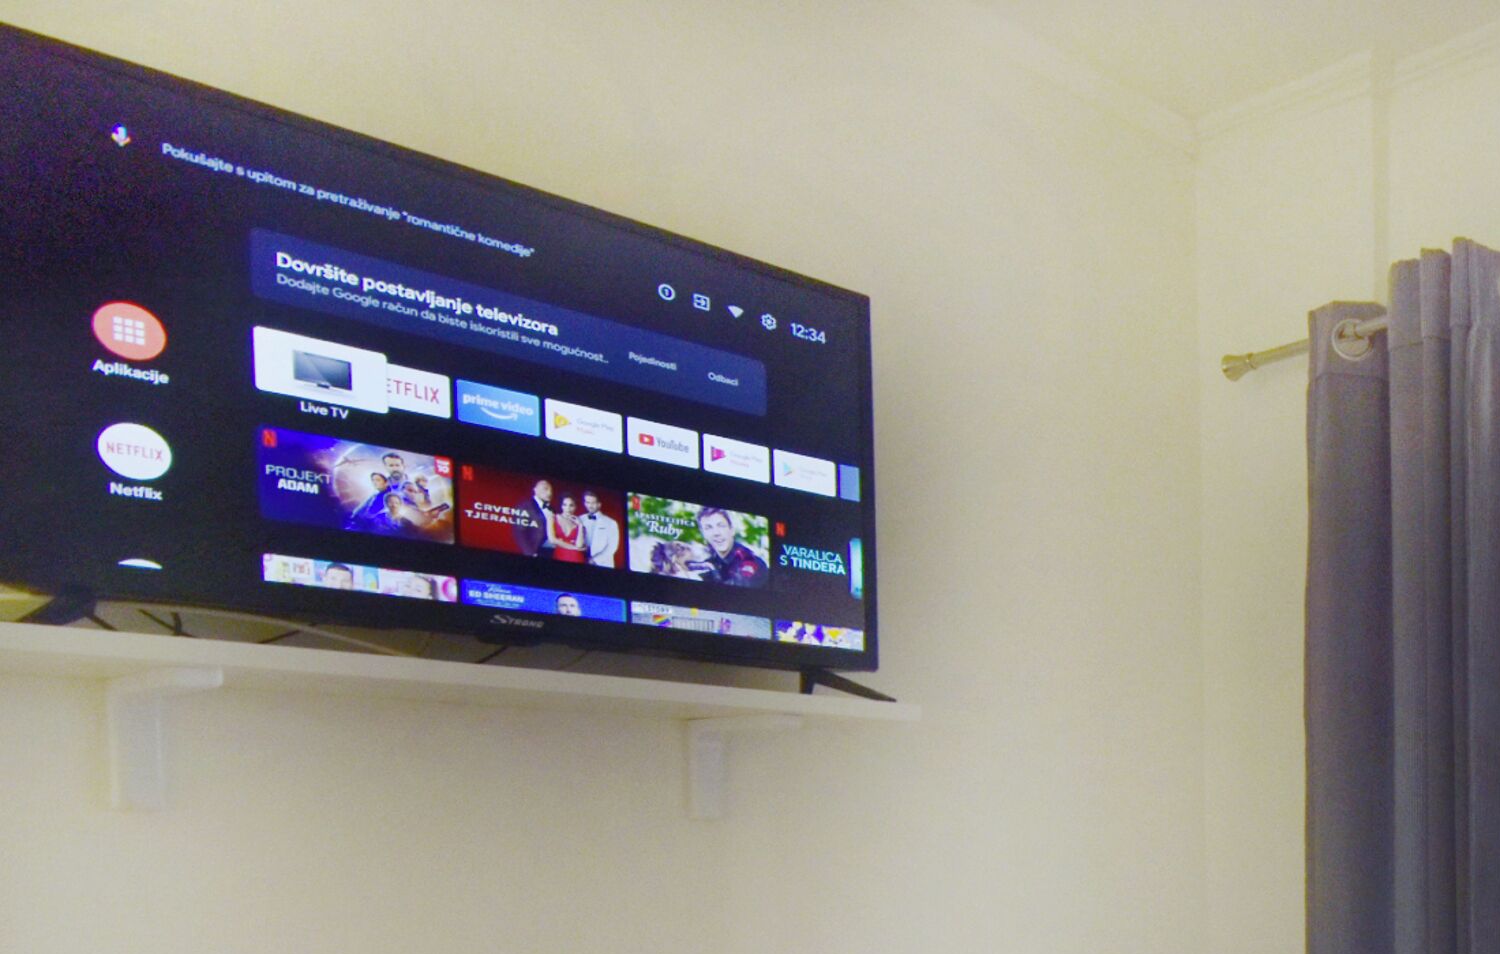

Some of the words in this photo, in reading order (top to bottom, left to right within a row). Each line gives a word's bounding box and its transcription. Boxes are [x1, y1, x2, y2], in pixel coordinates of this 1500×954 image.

[162, 142, 234, 172] Pokušajte
[235, 166, 245, 176] s
[247, 168, 297, 192] upitom
[299, 183, 315, 197] za
[317, 188, 401, 221] pretraživanje
[478, 233, 535, 258] komedije"
[276, 251, 360, 286] Dovršite
[362, 277, 473, 315] postavljanje
[476, 303, 559, 336] televizora
[276, 273, 330, 296] Dodajte
[332, 287, 380, 308] Google
[382, 301, 419, 317] račun
[420, 309, 437, 322] da
[438, 313, 468, 330] biste
[469, 320, 519, 342] iskoristili
[520, 334, 541, 348] sve
[790, 322, 827, 344] 12:34
[628, 351, 677, 371] Pojedinosti
[92, 359, 170, 385] Aplikacije
[708, 371, 739, 387] Odbaci
[386, 378, 440, 404] ETFLIX
[300, 401, 329, 417] Live
[330, 406, 349, 420] TV
[463, 394, 499, 409] prime
[500, 401, 534, 416] video
[106, 441, 163, 462] NETFLIX
[656, 437, 689, 453] YouTube
[265, 464, 332, 484] PROJEKT
[109, 482, 163, 501] Netflix
[277, 478, 319, 495] ADAM
[464, 509, 539, 528] TJERALICA
[473, 502, 530, 518] CRVENA
[646, 520, 683, 540] Ruby
[782, 544, 843, 564] VARALICA
[779, 555, 788, 567] S
[791, 556, 847, 576] TINDERA
